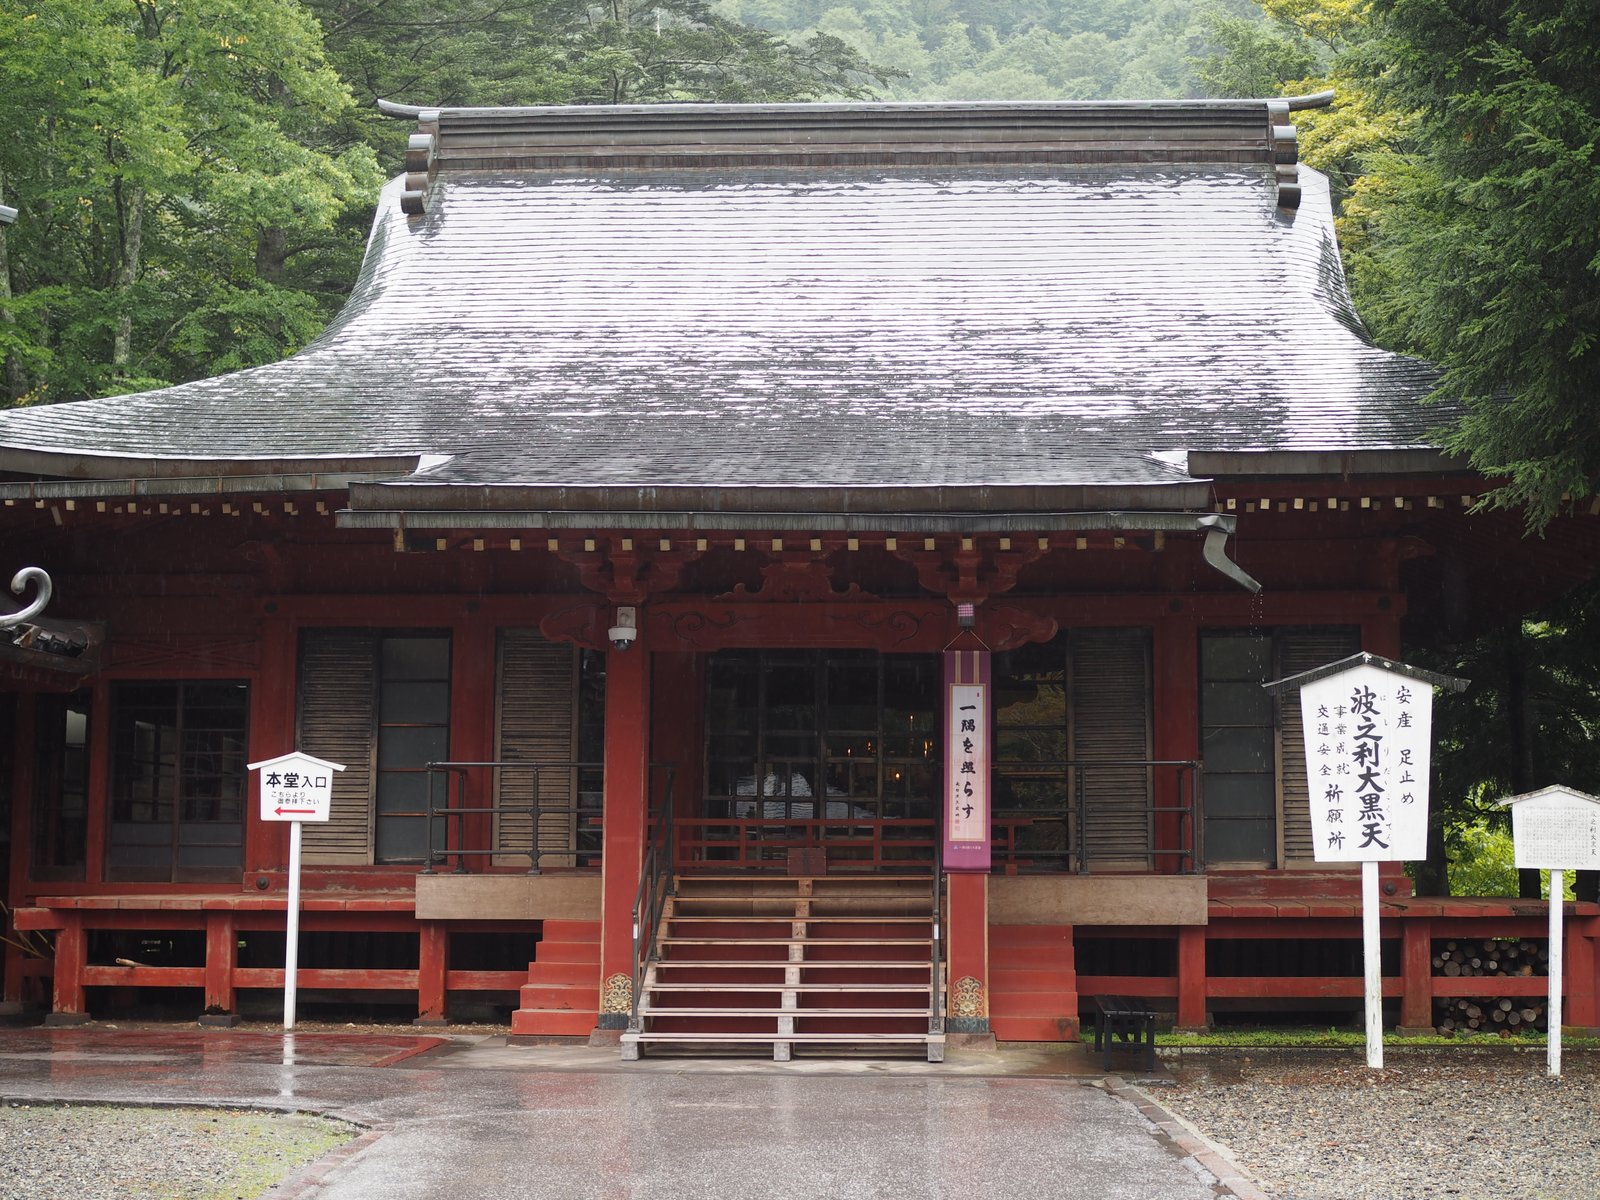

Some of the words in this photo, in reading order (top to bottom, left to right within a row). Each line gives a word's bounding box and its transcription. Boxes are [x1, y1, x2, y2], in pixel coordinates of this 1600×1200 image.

[1316, 704, 1332, 776] 交通安全
[1333, 704, 1351, 775] 事業成就
[1396, 685, 1413, 728] 安産
[265, 771, 327, 788] 本堂入口
[959, 705, 977, 819] 一隅を照らす
[1350, 685, 1389, 849] 波之利大黒天
[1399, 749, 1416, 805] 足止め
[1324, 783, 1347, 851] 祈願所
